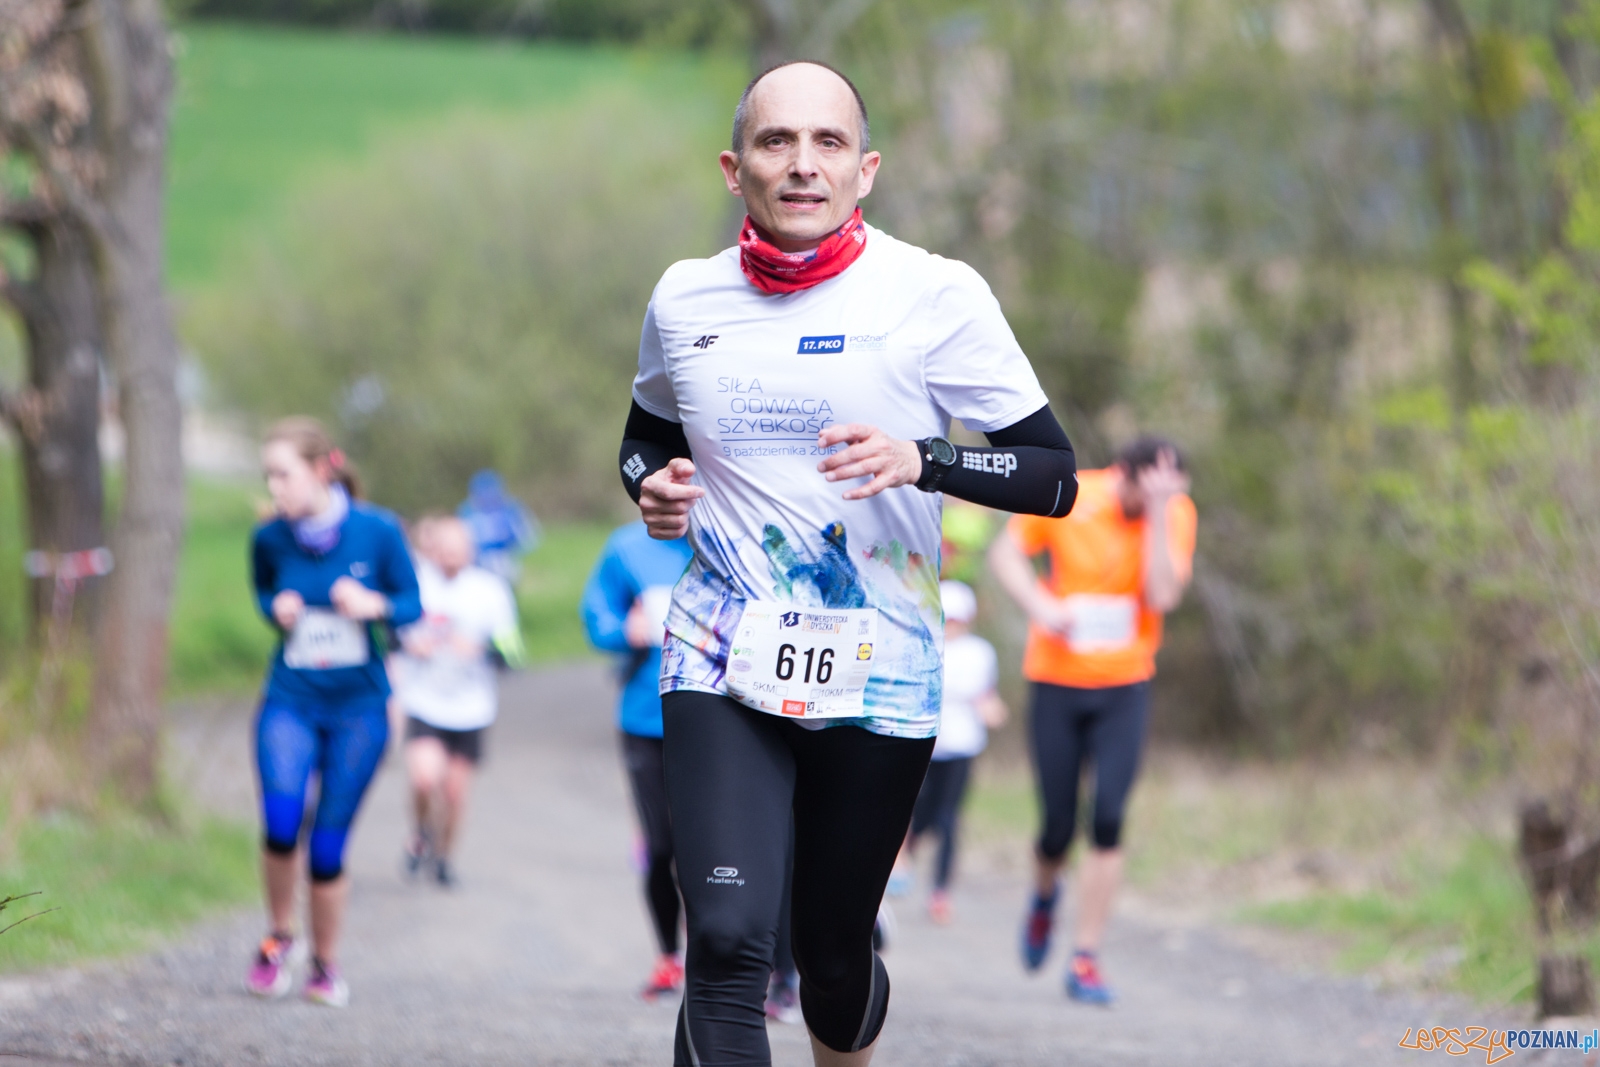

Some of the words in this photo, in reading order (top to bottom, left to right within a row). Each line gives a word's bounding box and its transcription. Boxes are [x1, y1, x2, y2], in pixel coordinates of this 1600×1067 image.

[693, 335, 719, 349] 4F
[803, 341, 817, 350] 17.
[817, 339, 842, 349] PKO
[717, 376, 763, 394] SIŁA
[730, 398, 834, 415] ODWAGA
[717, 416, 835, 434] SZYBKOŚĆ
[723, 446, 732, 457] 9
[734, 445, 807, 458] października
[982, 453, 1018, 478] cep
[803, 613, 849, 624] UNIWERSYTECKA
[775, 643, 835, 684] 616
[752, 681, 776, 694] 5KM
[820, 688, 844, 698] 10KM
